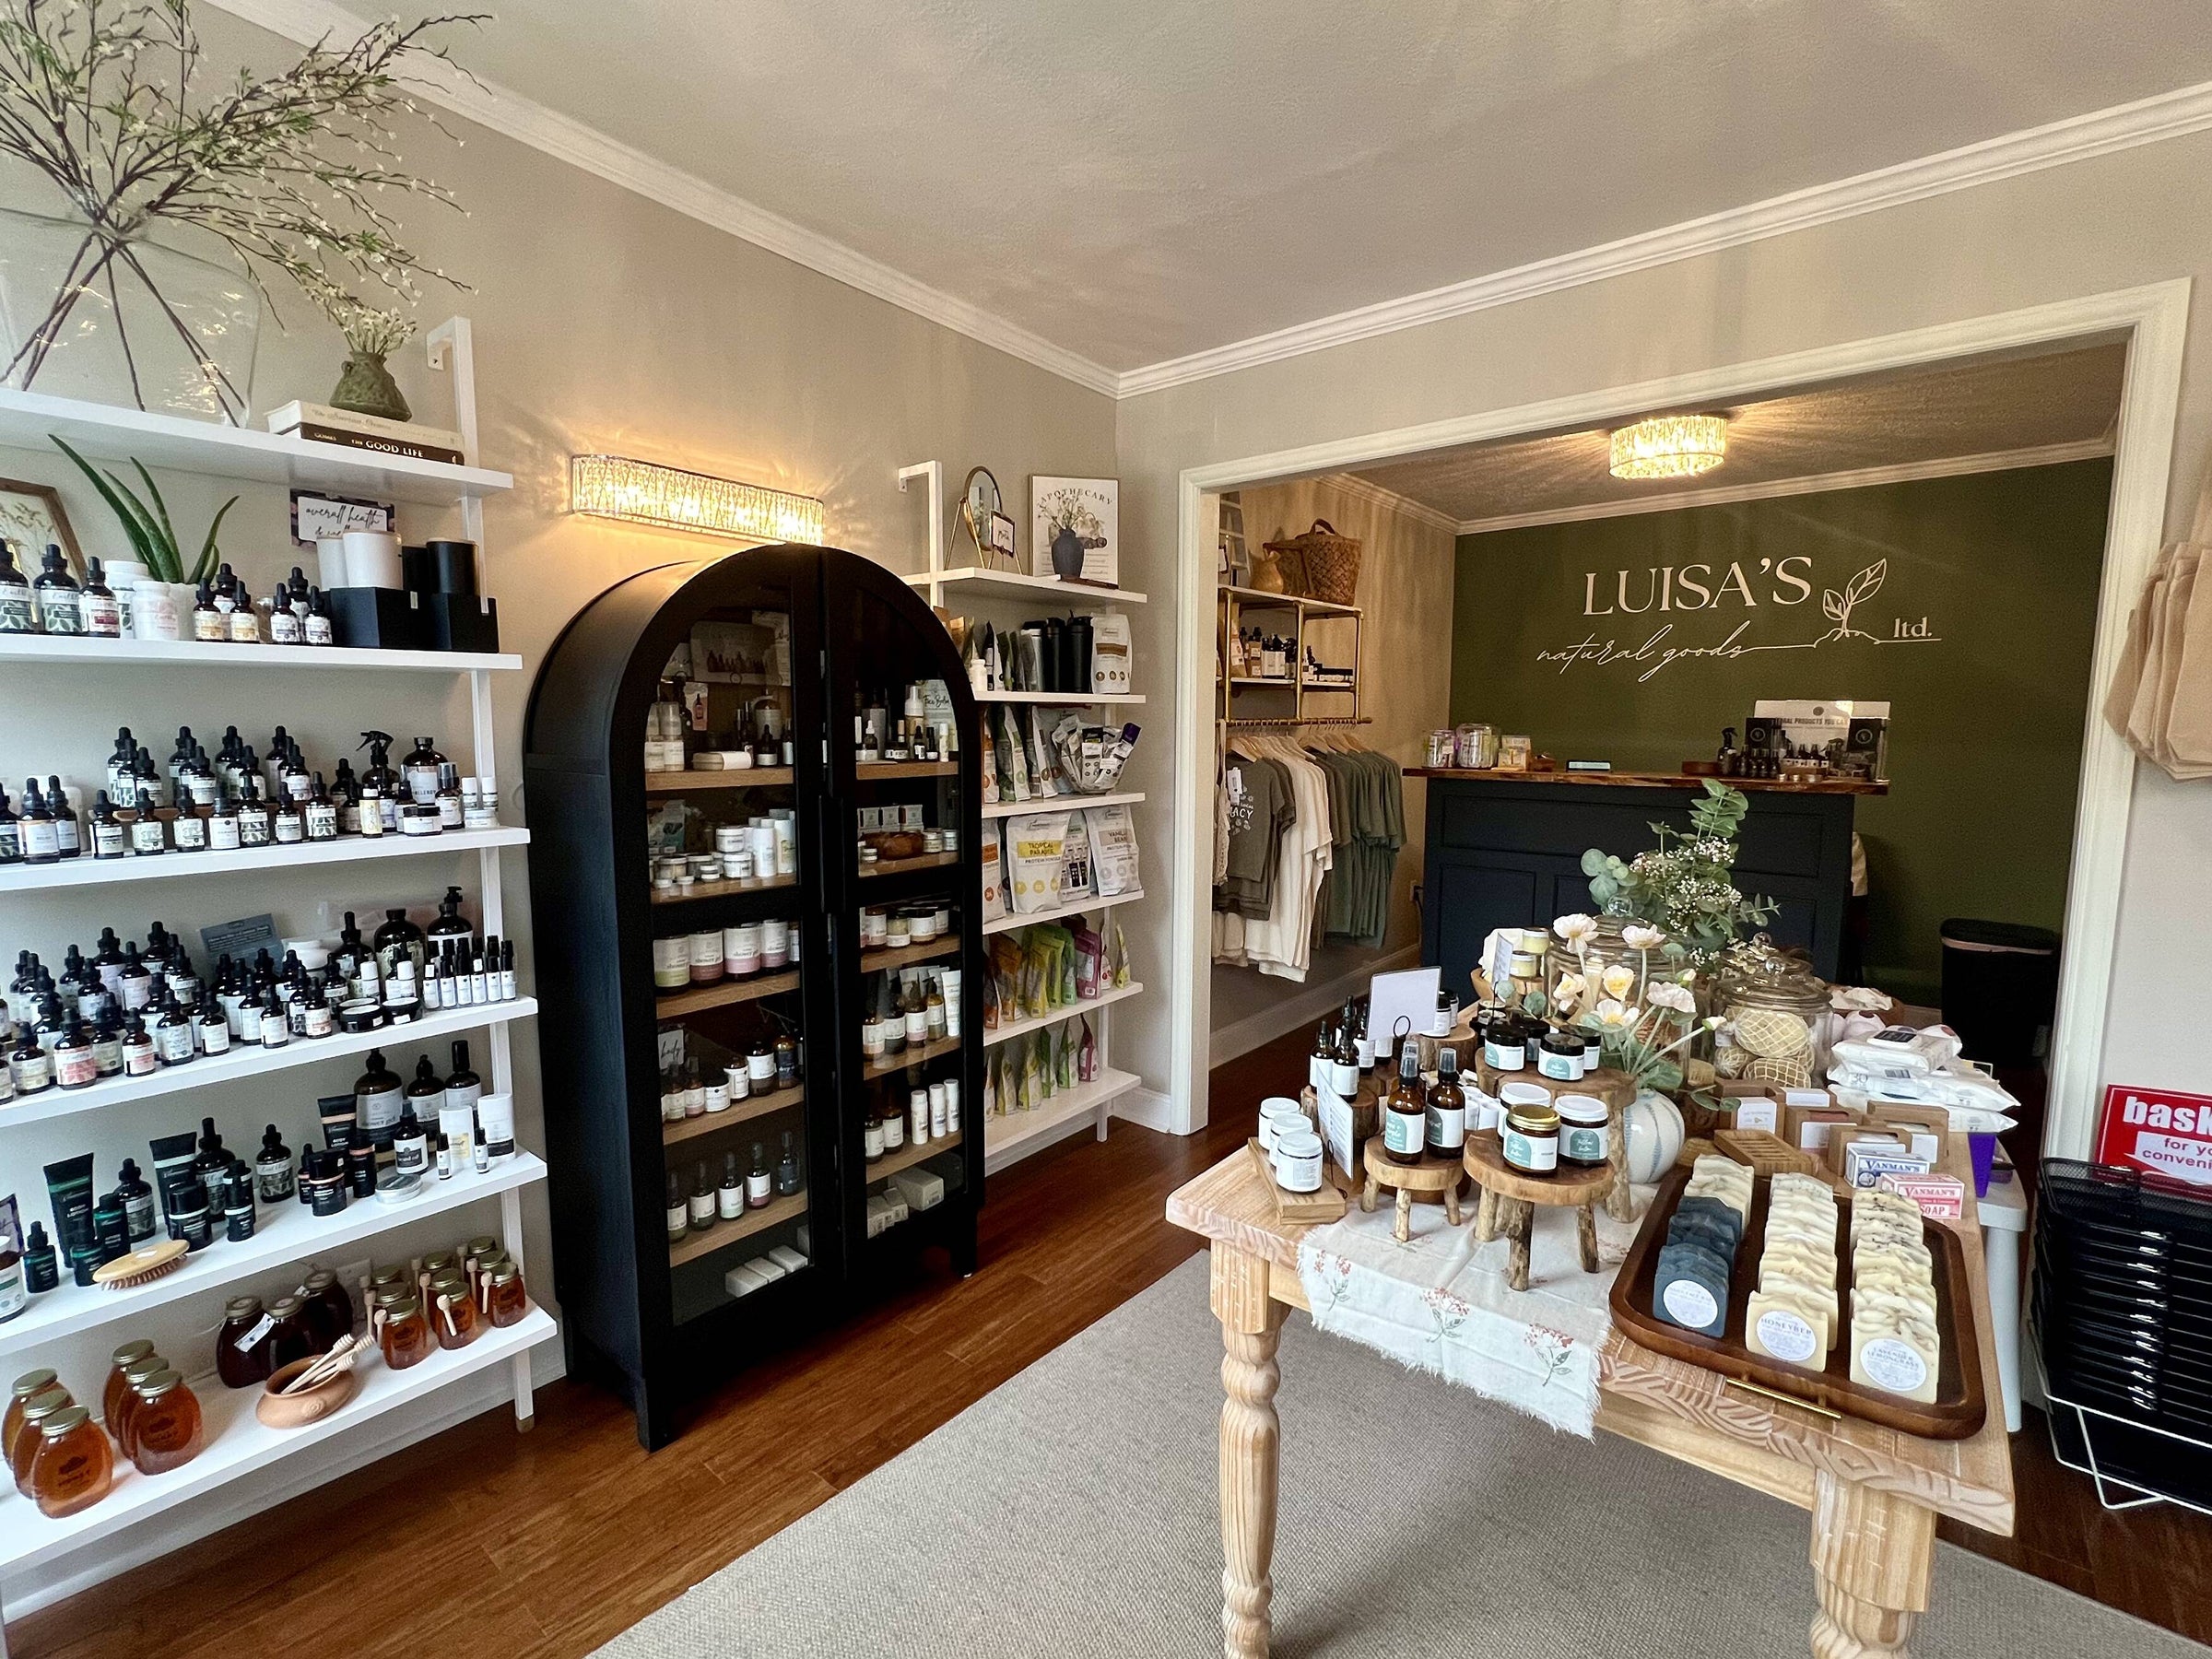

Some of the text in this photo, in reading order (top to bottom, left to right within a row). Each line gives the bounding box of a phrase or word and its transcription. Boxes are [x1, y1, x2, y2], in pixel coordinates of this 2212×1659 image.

[365, 440, 399, 453] GOOD
[403, 447, 424, 458] LIFE
[305, 504, 383, 529] overall health
[1583, 556, 1813, 616] LUISA'S
[1536, 616, 1933, 683] natural goods ltd.
[1794, 717, 1823, 725] PRODUCTS
[1851, 1073, 1868, 1083] 30
[2164, 1137, 2190, 1151] for
[1865, 1159, 1920, 1172] VANMAN'S
[2142, 1149, 2212, 1170] conveni
[1904, 1187, 1956, 1197] VANMAN'S
[1921, 1205, 1946, 1215] SOAP
